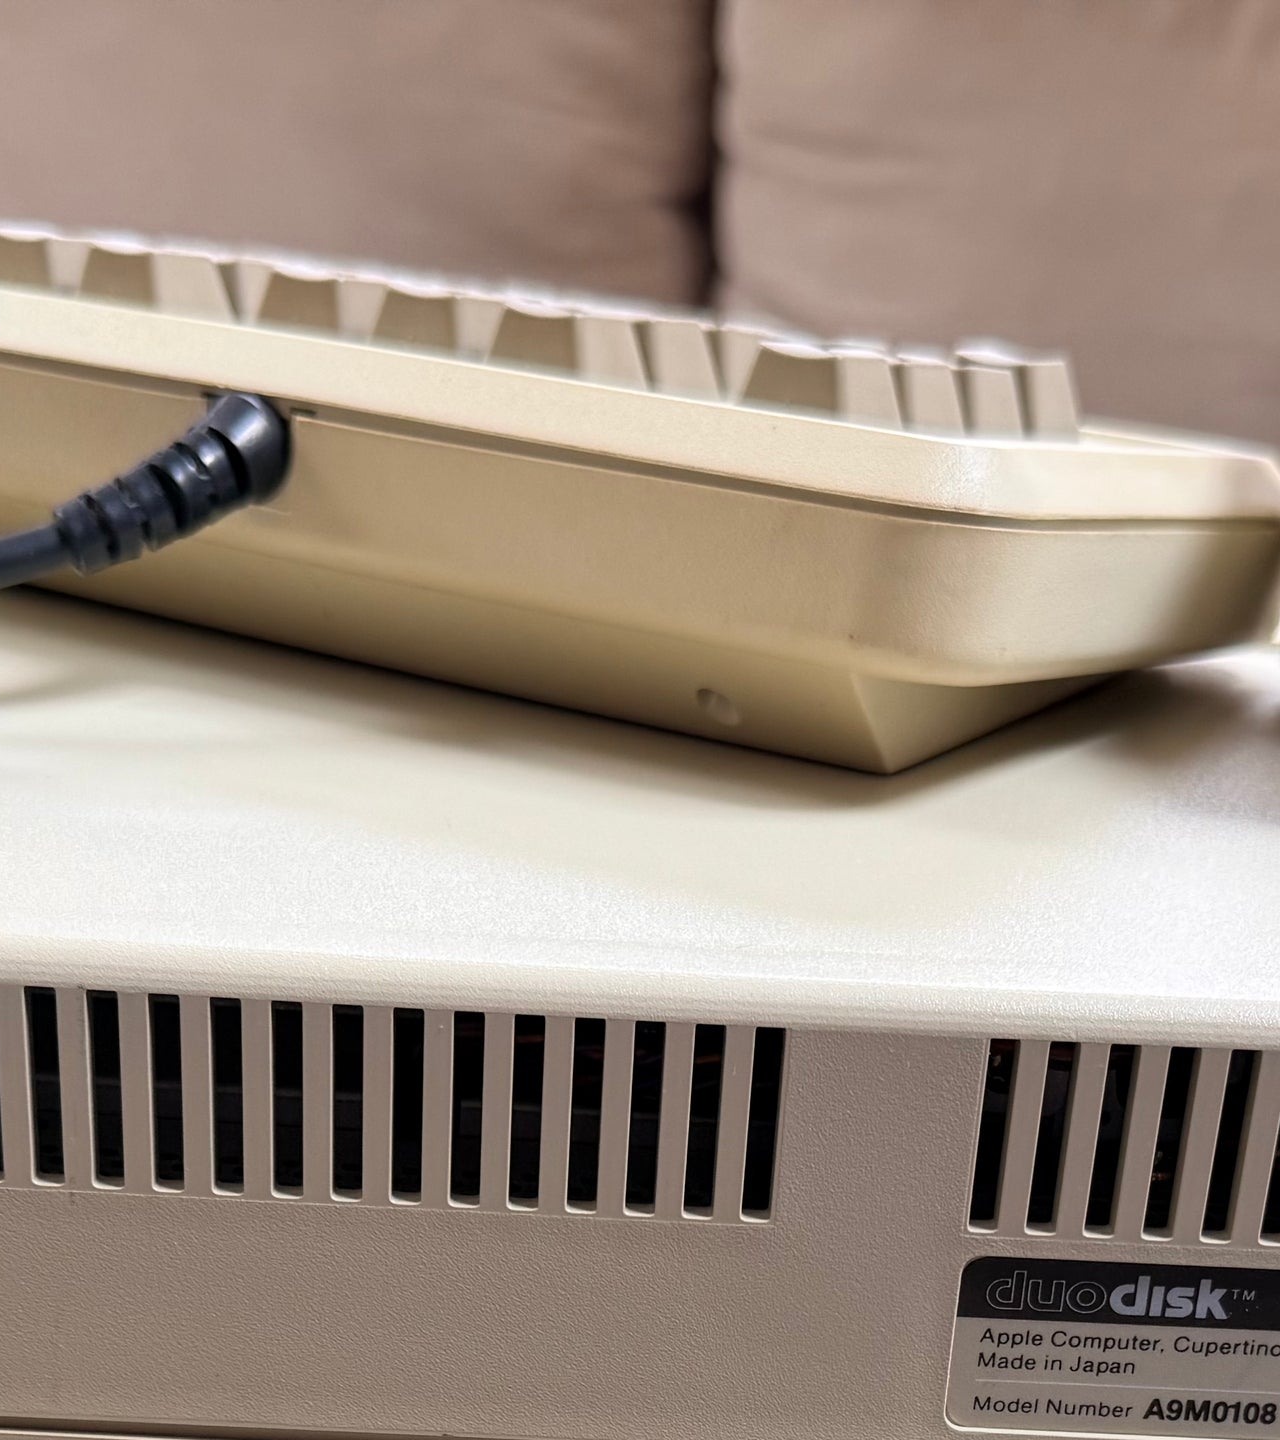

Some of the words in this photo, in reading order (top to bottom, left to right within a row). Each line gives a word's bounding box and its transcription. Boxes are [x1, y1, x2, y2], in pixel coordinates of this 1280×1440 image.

[979, 1328, 1044, 1349] Apple
[1050, 1331, 1165, 1354] Computer,
[976, 1352, 1037, 1371] Made
[1044, 1354, 1063, 1372] in
[1069, 1356, 1136, 1377] Japan
[972, 1395, 1039, 1415] Model
[1045, 1398, 1134, 1419] Number
[1142, 1398, 1278, 1425] A9M0108
